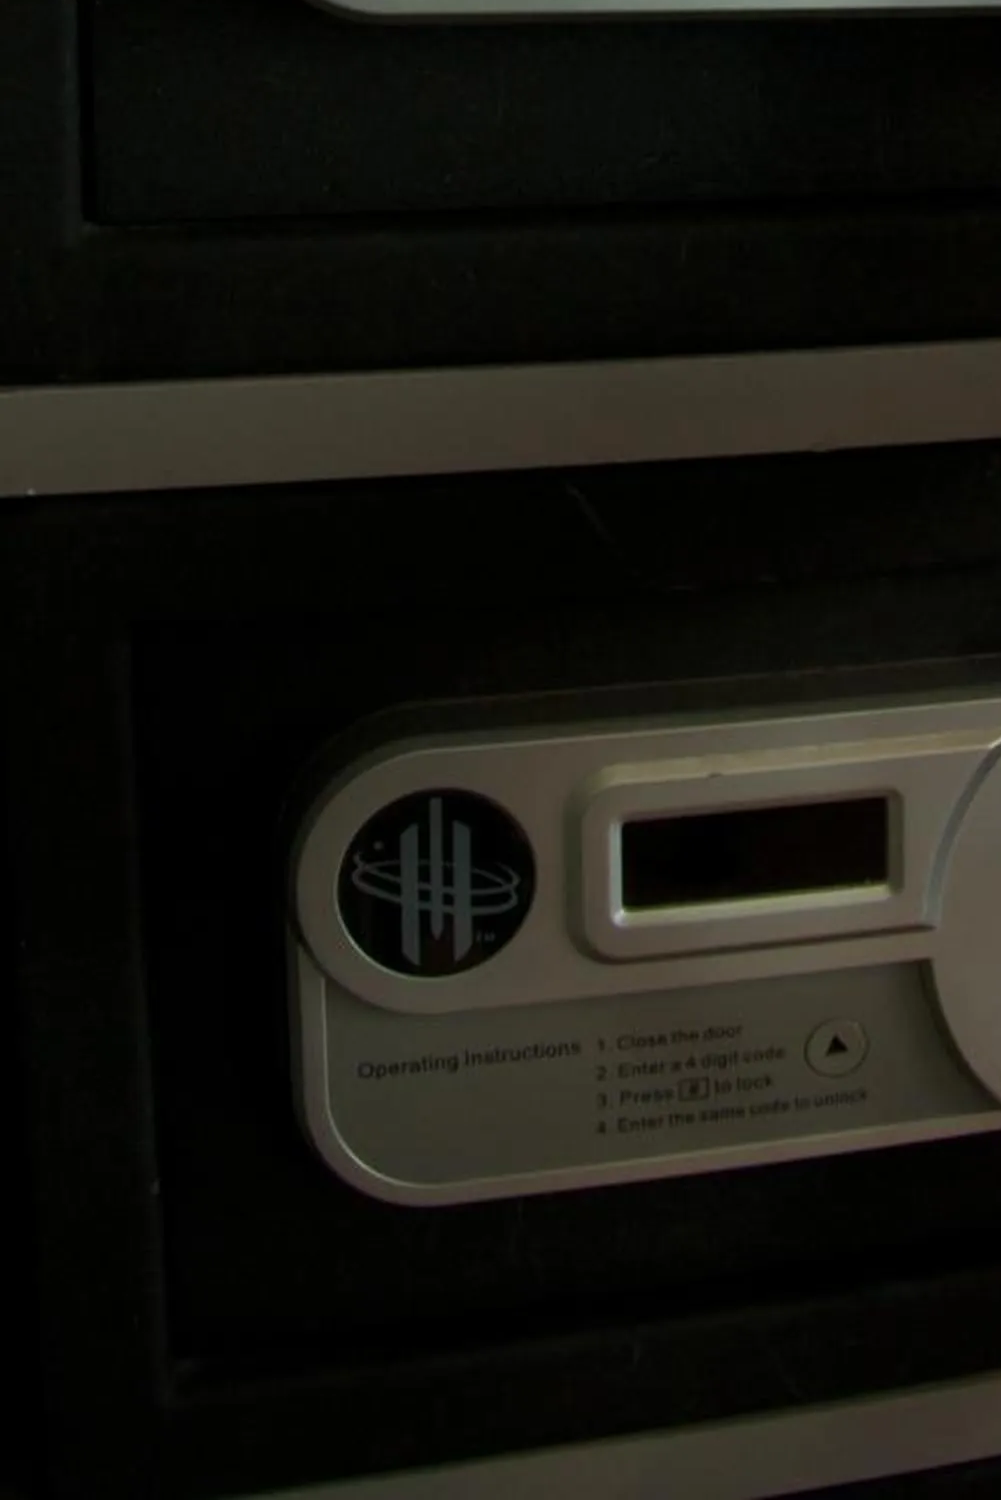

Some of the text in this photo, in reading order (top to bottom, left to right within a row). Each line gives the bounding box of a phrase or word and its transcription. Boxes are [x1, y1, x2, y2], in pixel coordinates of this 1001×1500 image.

[617, 1034, 668, 1051] Close
[671, 1029, 699, 1043] the
[702, 1025, 742, 1041] door
[357, 1041, 581, 1079] Operating Instructions
[618, 1061, 665, 1078] Enter
[700, 1051, 739, 1070] digit
[742, 1047, 786, 1064] code
[620, 1089, 674, 1105] Press
[714, 1078, 732, 1095] to
[736, 1074, 772, 1091] lock
[617, 1116, 664, 1133] Enter
[668, 1112, 695, 1128] the
[699, 1107, 745, 1123] same
